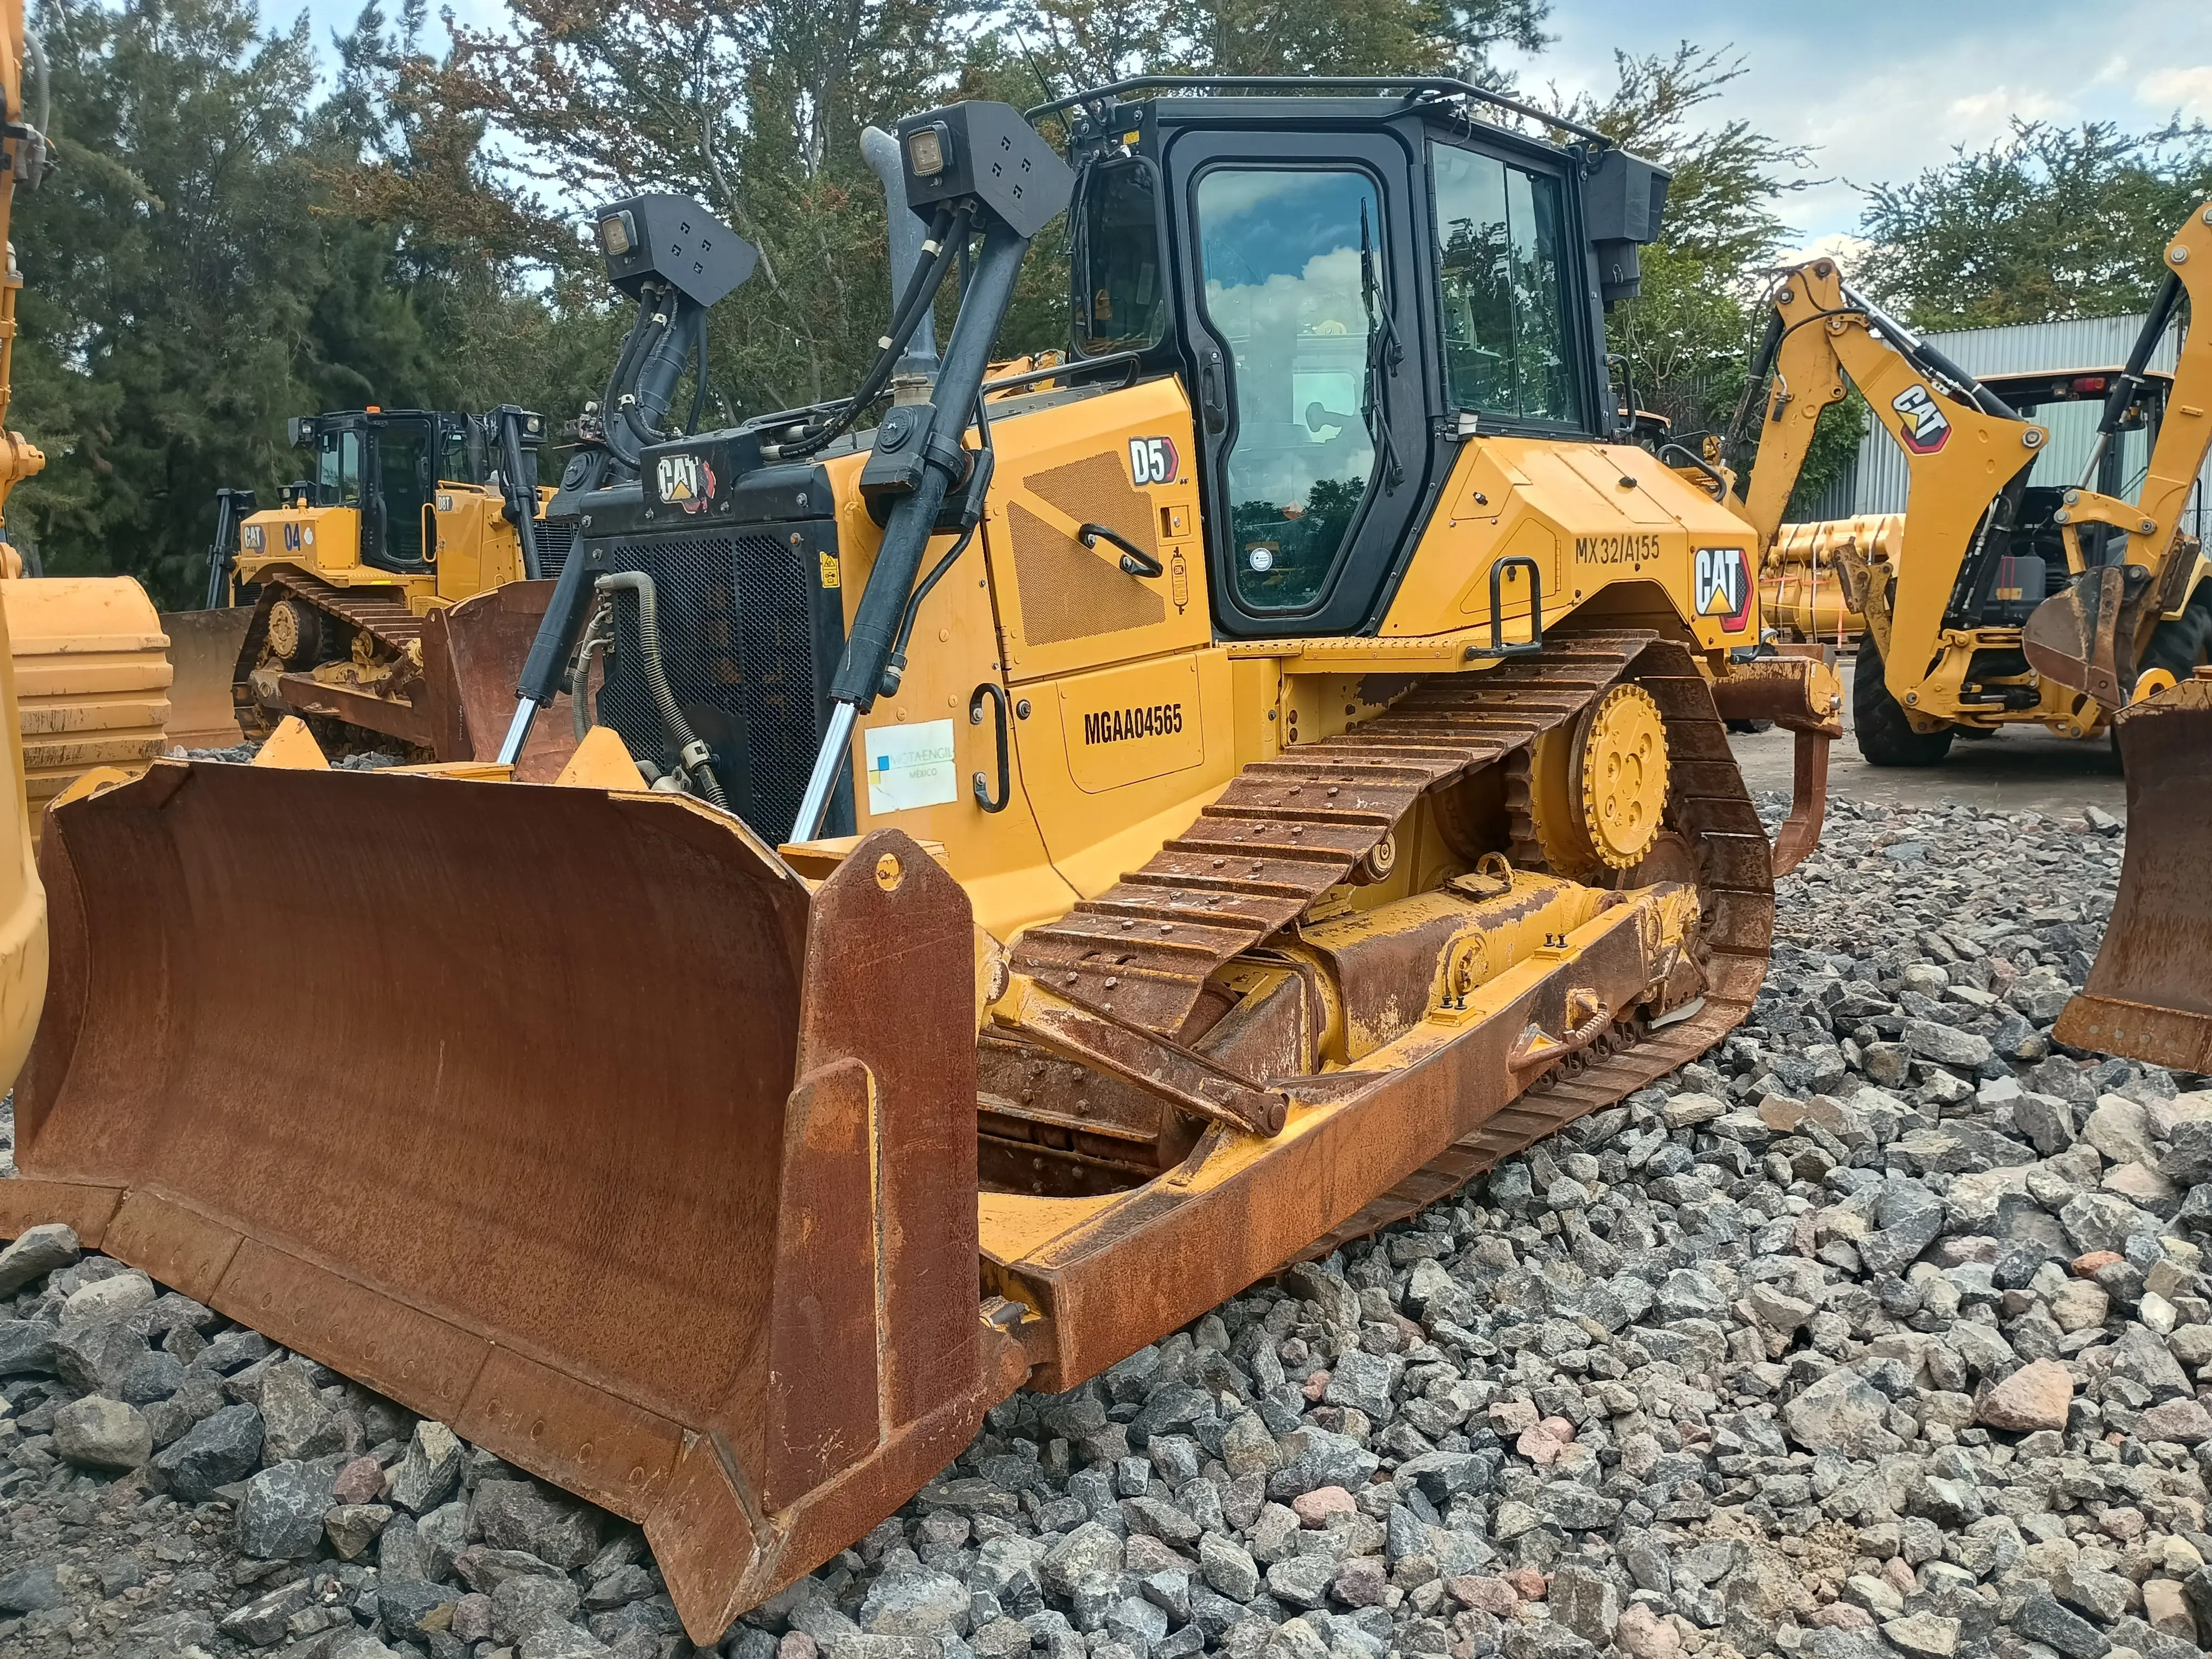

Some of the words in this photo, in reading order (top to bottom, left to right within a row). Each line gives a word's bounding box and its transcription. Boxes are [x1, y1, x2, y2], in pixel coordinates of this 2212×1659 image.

[1893, 385, 1947, 439] CAT
[659, 456, 698, 500] CAT
[1130, 439, 1165, 483] D5
[438, 496, 449, 510] D8T
[245, 526, 260, 548] CAT
[284, 523, 301, 551] 04
[1696, 550, 1739, 614] CAT
[1084, 704, 1182, 745] MGAA04565
